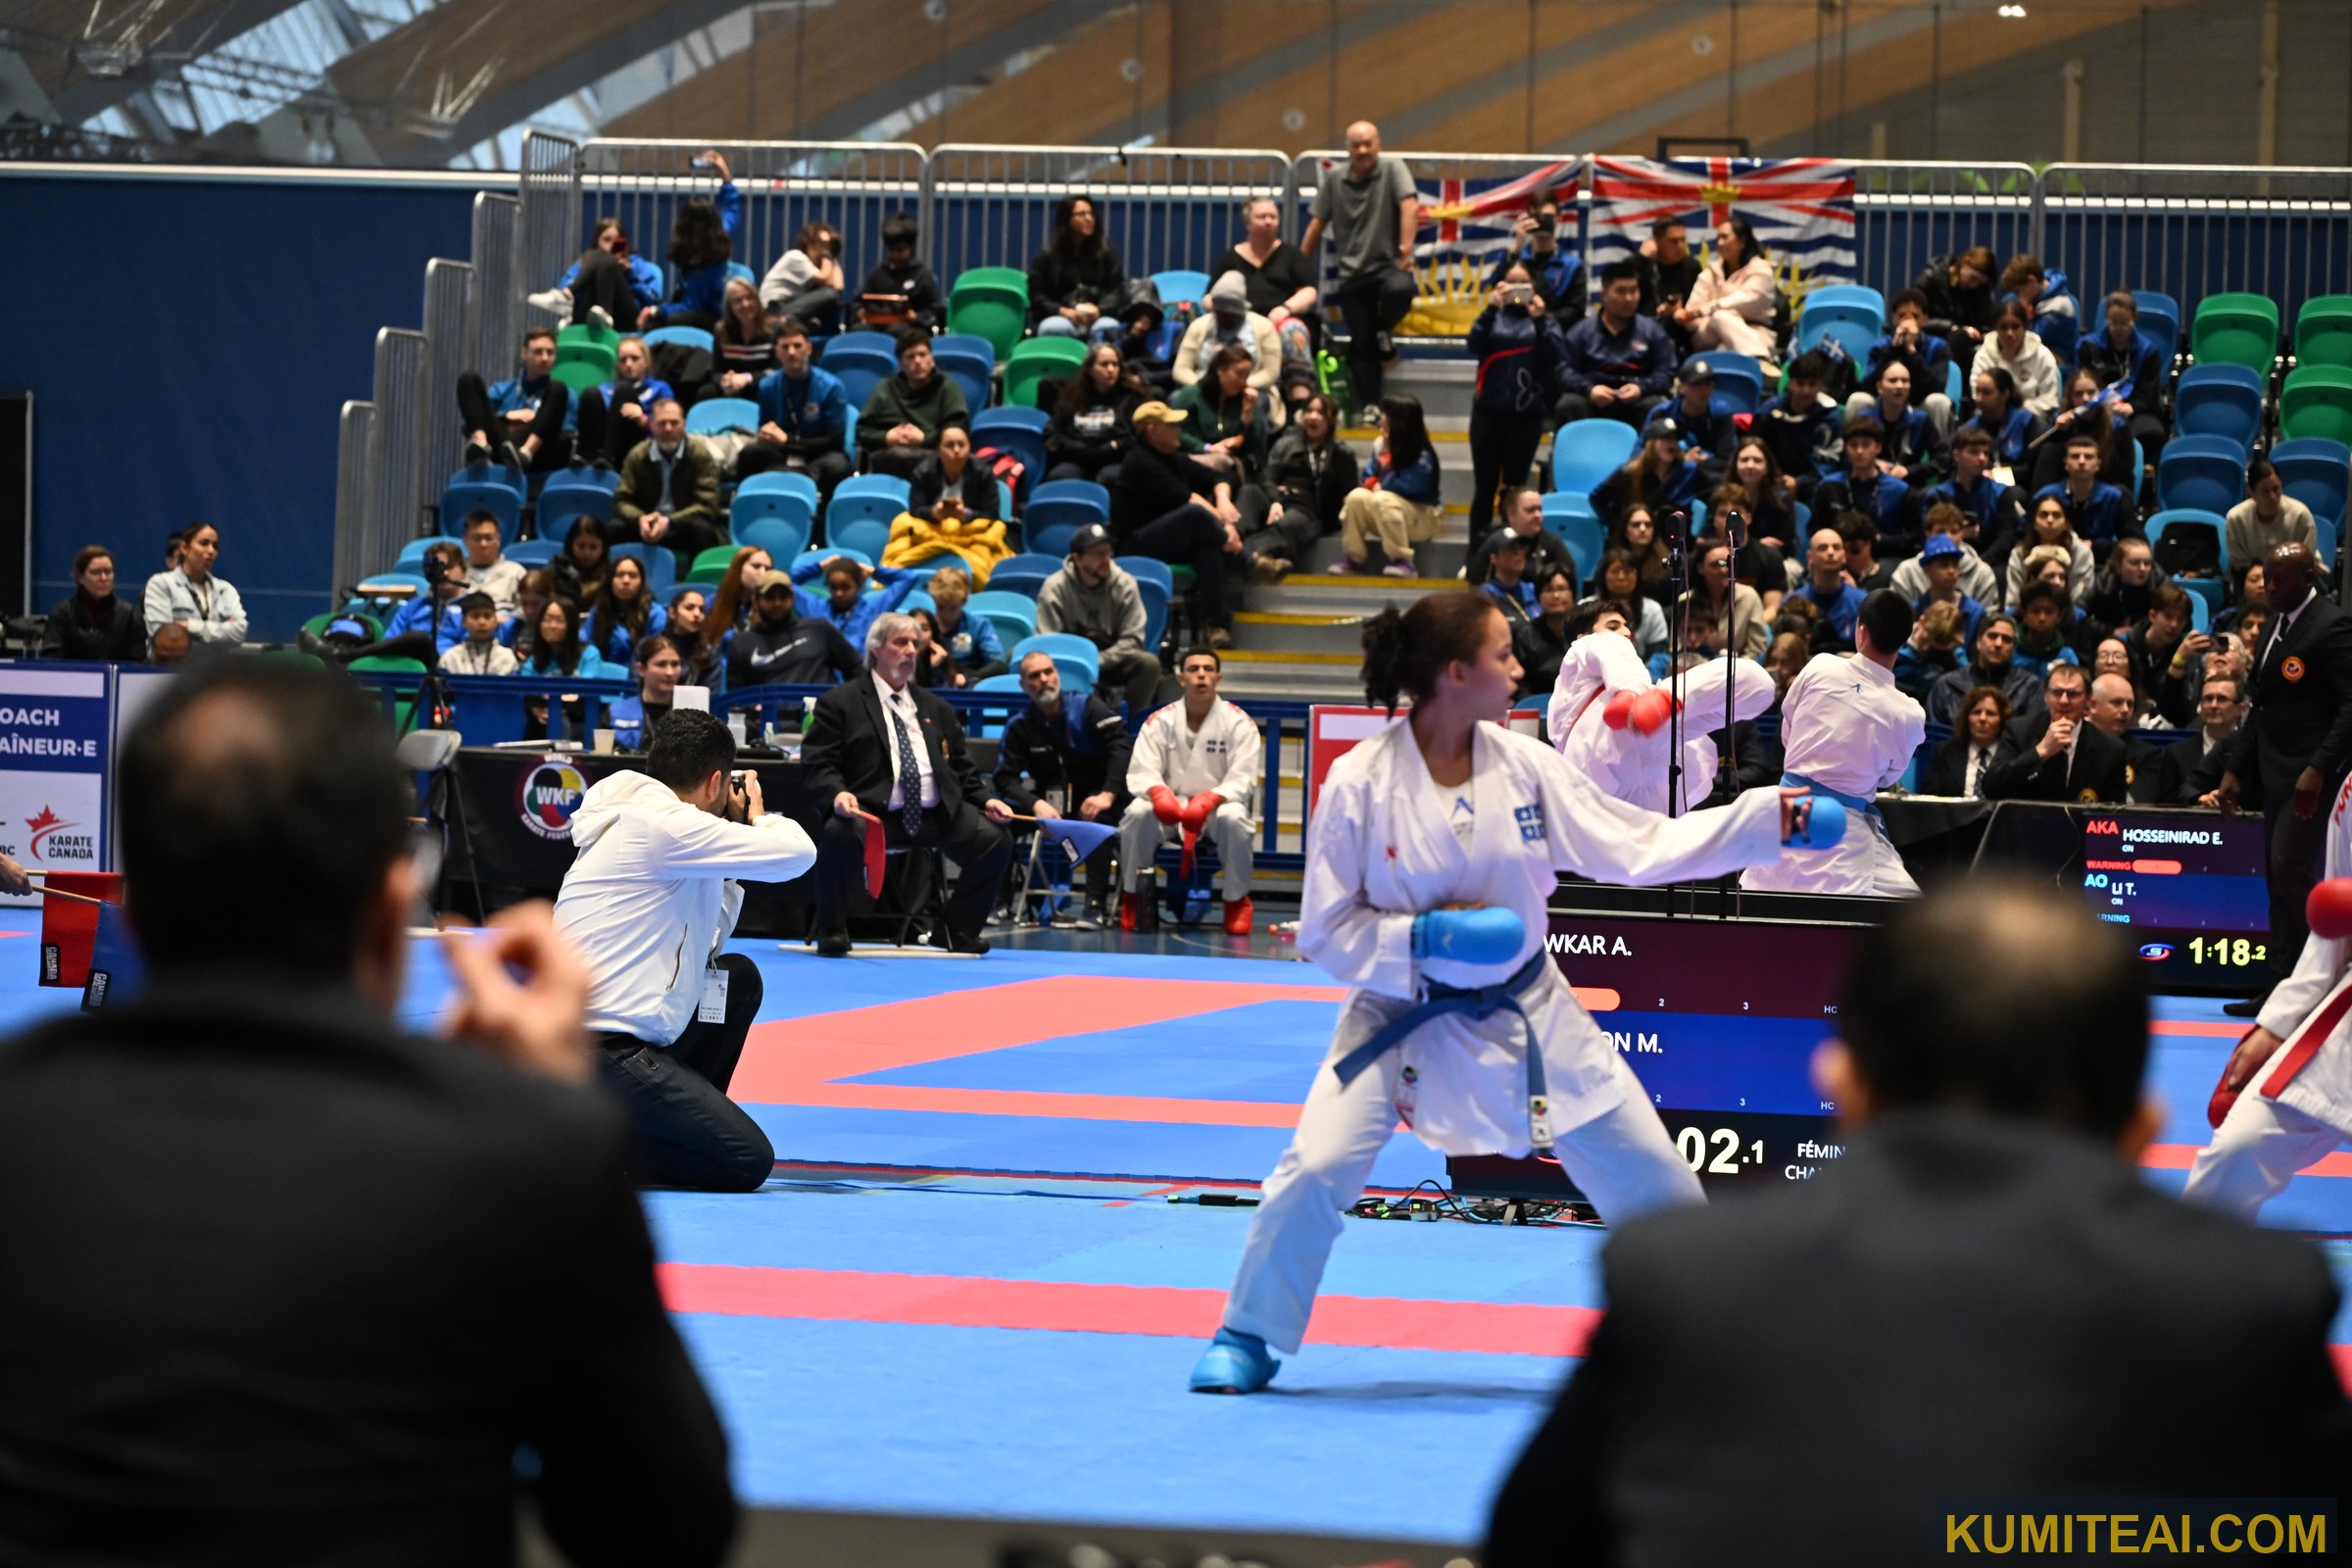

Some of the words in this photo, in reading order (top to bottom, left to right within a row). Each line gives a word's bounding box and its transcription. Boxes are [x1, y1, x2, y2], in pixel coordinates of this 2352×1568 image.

[0, 708, 60, 726] OACH
[536, 786, 576, 807] WKF
[2086, 820, 2120, 835] AKA
[48, 835, 93, 848] KARATE
[2123, 828, 2210, 845] HOSSEINIRAD
[2212, 832, 2224, 846] E.
[48, 848, 94, 859] CANADA
[2086, 860, 2132, 871] WARNING
[2084, 873, 2108, 888] AO
[2125, 882, 2136, 897] T.
[1544, 933, 1607, 956] WKAR
[1611, 936, 1633, 956] A.
[2188, 937, 2267, 966] 1:18.2
[1658, 998, 1665, 1007] 2
[1742, 1002, 1749, 1010] 3
[1824, 1005, 1838, 1015] HC
[1638, 1032, 1663, 1054] M.
[1655, 1094, 1662, 1102] 2
[1740, 1098, 1746, 1106] 3
[1821, 1102, 1835, 1110] HC
[1785, 1164, 1822, 1180] CHA
